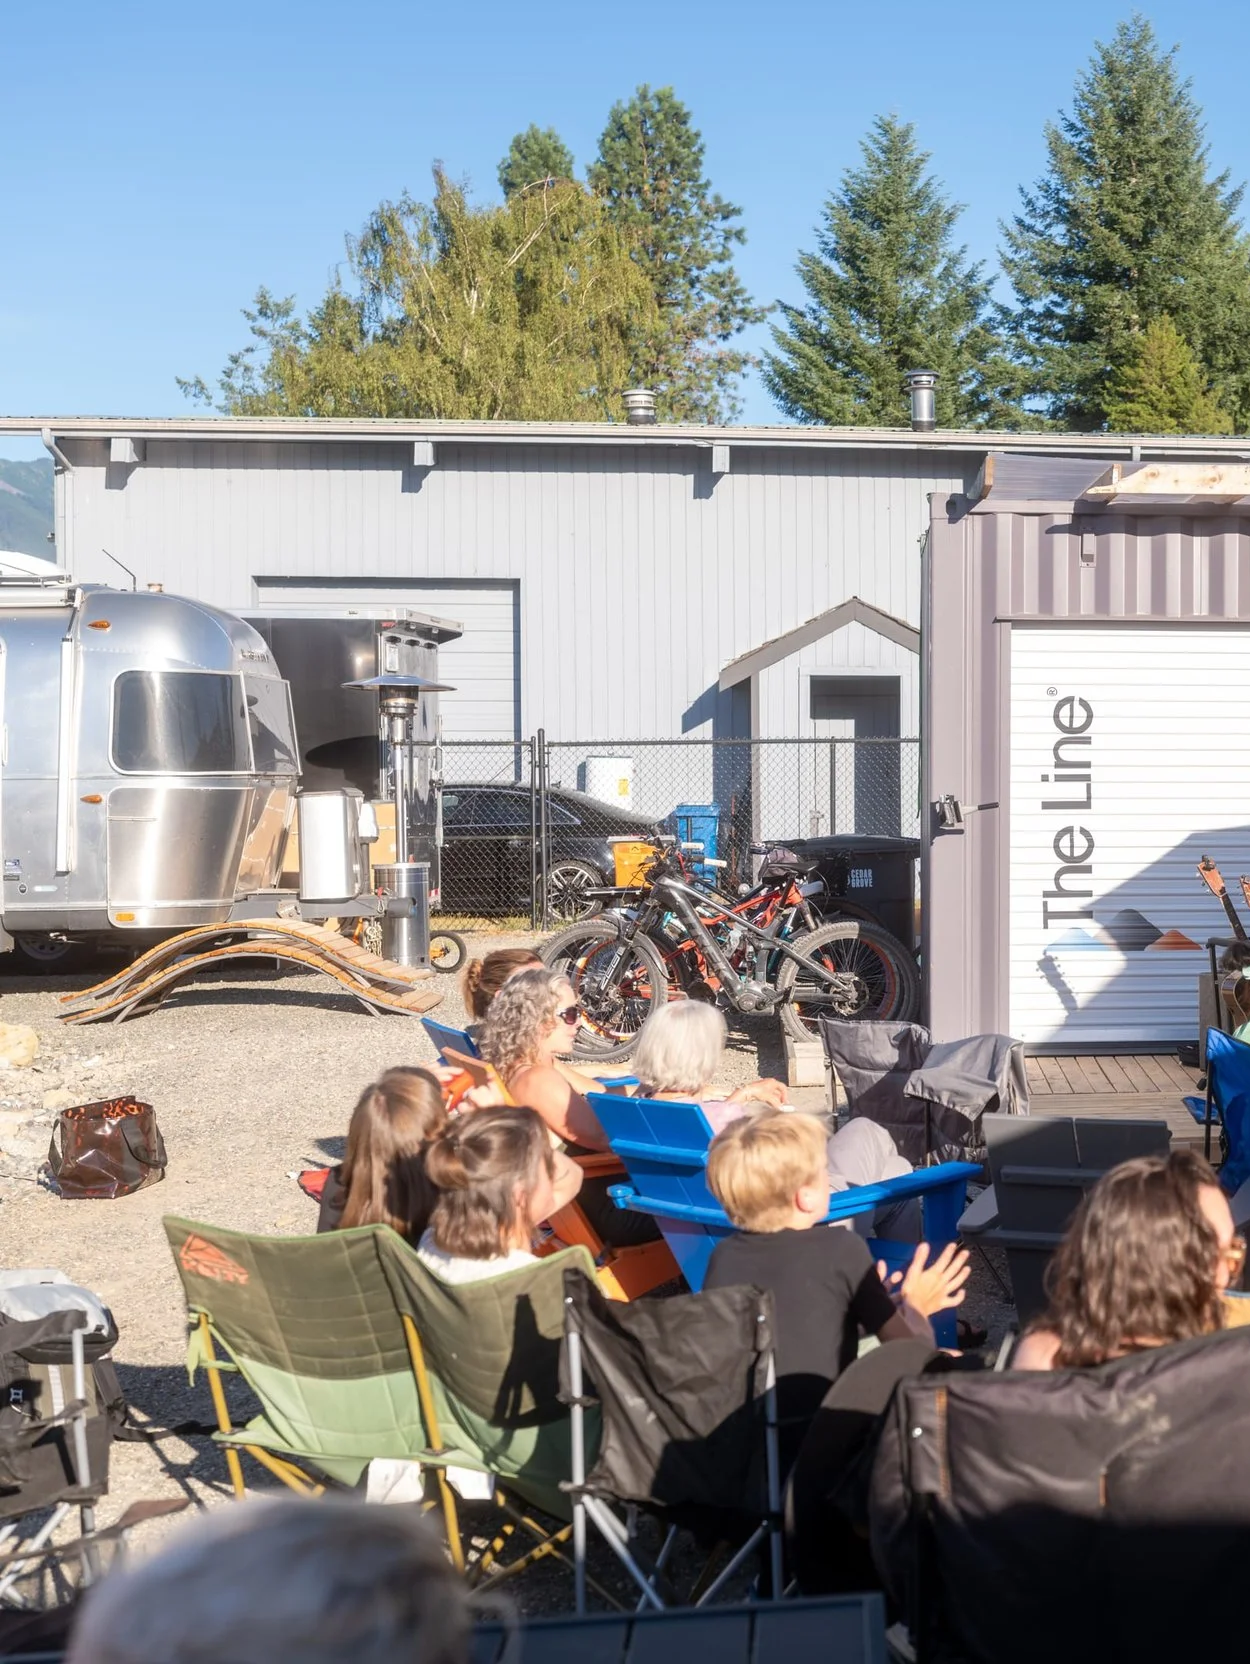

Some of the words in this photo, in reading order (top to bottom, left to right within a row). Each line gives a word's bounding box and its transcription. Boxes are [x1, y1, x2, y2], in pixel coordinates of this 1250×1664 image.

[850, 869, 873, 878] CEDAR
[1042, 825, 1095, 930] The
[851, 878, 873, 888] GROVE
